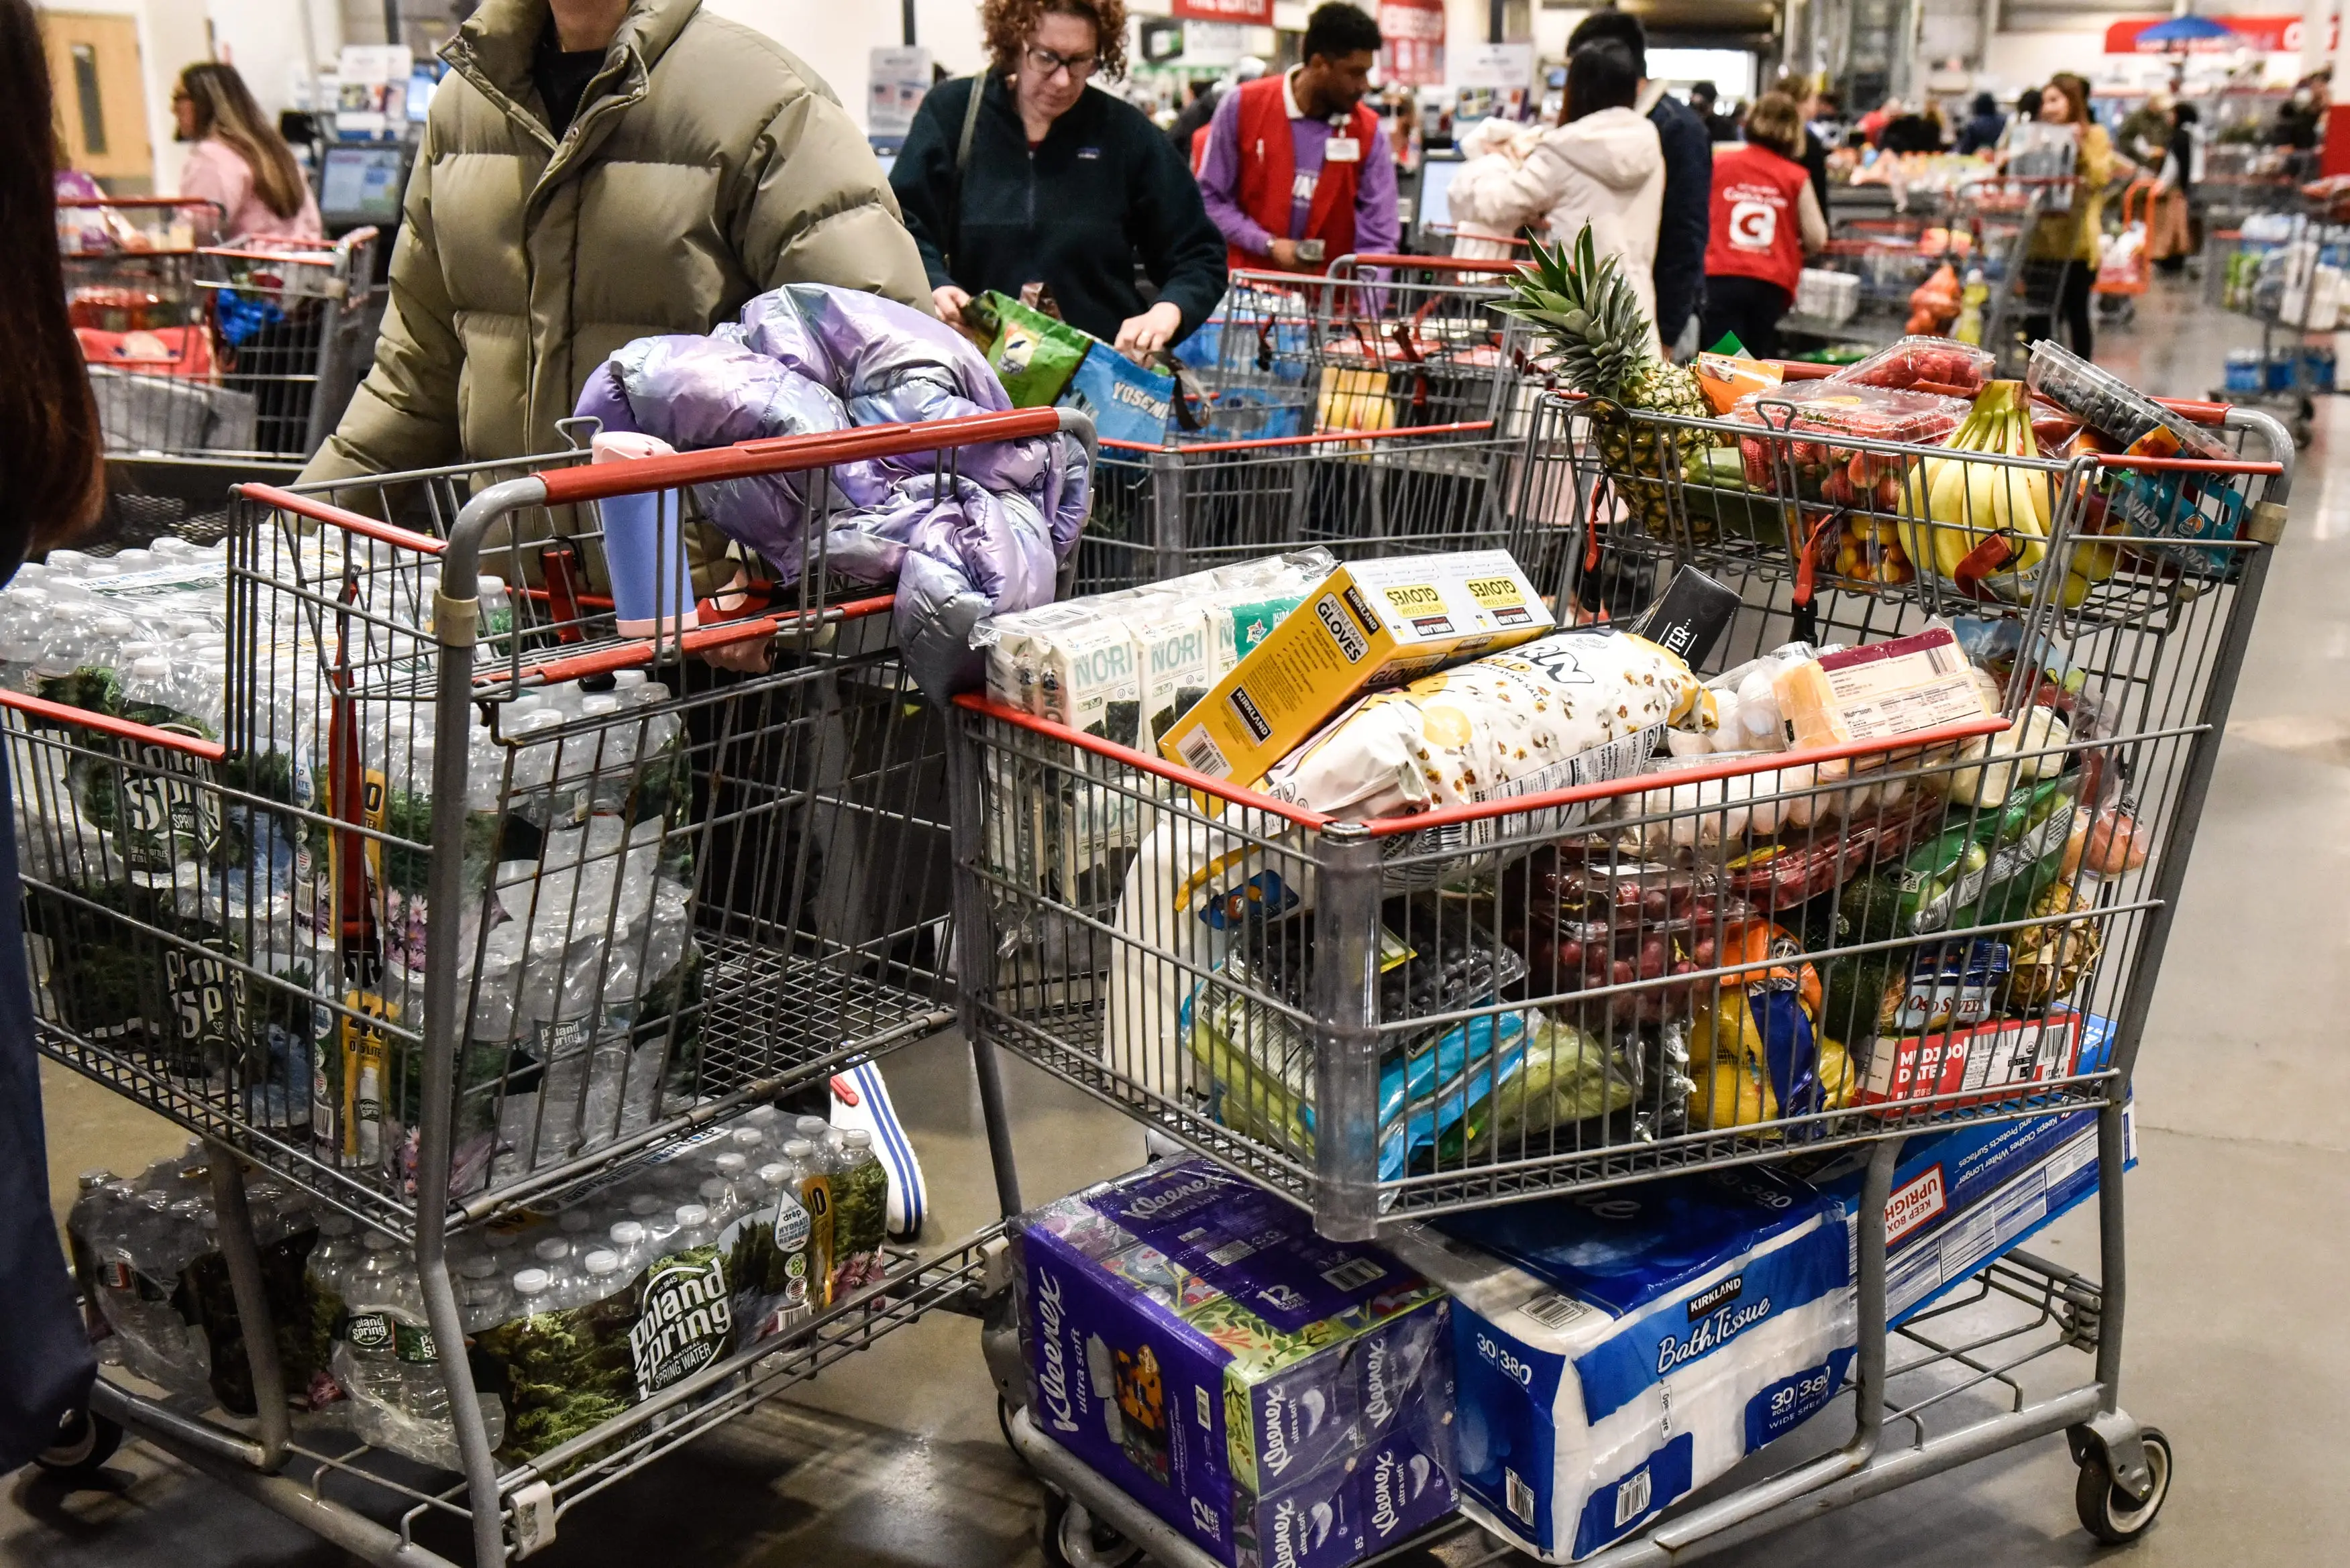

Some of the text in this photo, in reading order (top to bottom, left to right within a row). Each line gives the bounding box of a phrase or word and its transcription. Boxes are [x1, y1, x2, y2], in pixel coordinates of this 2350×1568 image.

[1348, 589, 1377, 630] KIRKLAND
[1387, 587, 1438, 606] GLOVES
[1468, 579, 1516, 598] GLOVES
[1318, 602, 1361, 661] GLOVES
[1330, 599, 1364, 649] NITRILE EXAM
[1418, 624, 1453, 636] KIRKLAND
[1075, 641, 1133, 688] NORI
[1152, 630, 1203, 673] NORI
[1236, 690, 1268, 736] KIRKLAND
[1523, 683, 1544, 702] SALT
[366, 1046, 382, 1058] LITE
[1958, 1118, 2033, 1168] and Protects Surfaces
[1984, 1116, 2058, 1169] Keeps Clothes Whiter
[782, 1209, 802, 1222] drop
[1120, 1173, 1227, 1220] Kleenex
[1885, 1178, 1937, 1222] UPRIGH
[1887, 1199, 1931, 1234] KEEP BOX
[778, 1215, 809, 1235] HYDRATE
[663, 1275, 678, 1289] 1845
[1691, 1278, 1742, 1312] KIRKLAND
[673, 1341, 701, 1360] NATURAL
[1038, 1266, 1079, 1432] Kleenex
[1658, 1298, 1770, 1374] Bath Tissue
[655, 1342, 712, 1389] SPRING WATER
[1070, 1327, 1087, 1414] ultra soft
[1477, 1333, 1496, 1359] 30
[1499, 1349, 1532, 1386] 380
[1365, 1338, 1393, 1428] Kleenex
[1662, 1393, 1670, 1413] Ope
[1771, 1386, 1794, 1410] 30
[1799, 1365, 1831, 1398] 380
[1263, 1384, 1294, 1477] Kleenex
[1287, 1398, 1299, 1444] ultra soft
[1769, 1412, 1795, 1429] WIDE
[1772, 1403, 1792, 1417] ROLLS
[1371, 1448, 1399, 1537] Kleenex
[1396, 1462, 1405, 1507] ultra soft
[1450, 1488, 1458, 1503] 85
[1191, 1496, 1212, 1534] 12
[1297, 1510, 1308, 1555] ultra soft
[1354, 1535, 1364, 1551] 85
